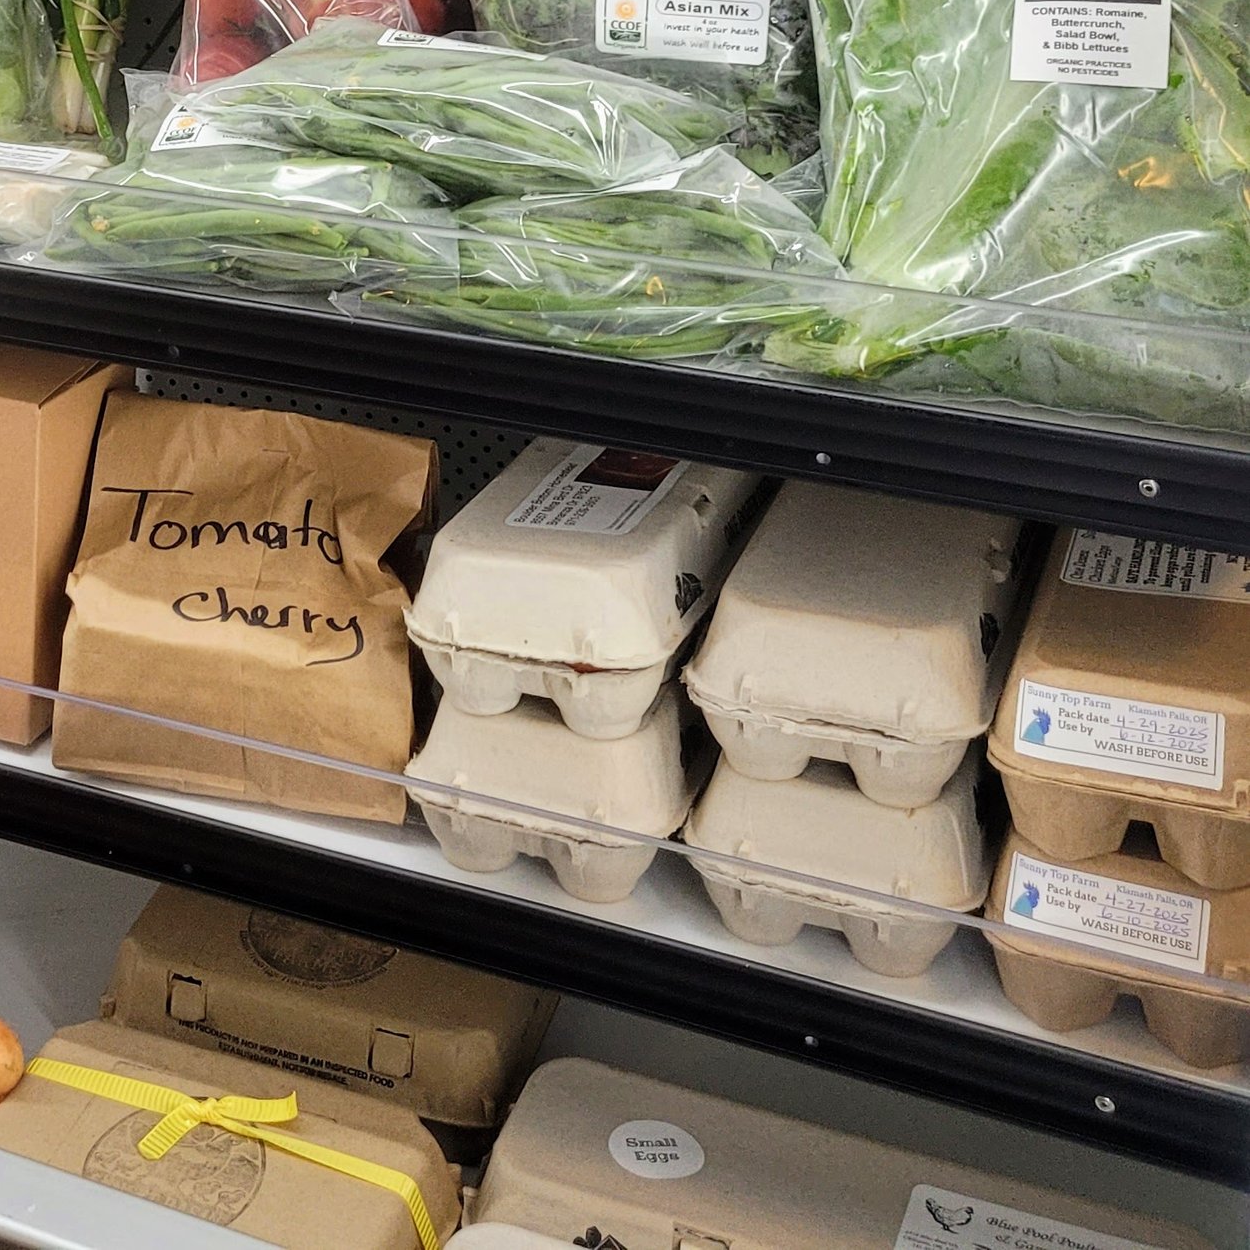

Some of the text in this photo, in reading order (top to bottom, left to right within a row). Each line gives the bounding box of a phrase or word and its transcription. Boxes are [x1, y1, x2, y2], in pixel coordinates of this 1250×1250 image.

[664, 1, 750, 17] Asian Mix
[1032, 7, 1147, 19] CONTAINS: Romaine,
[611, 20, 642, 31] CCOF
[1051, 19, 1125, 30] Buttercrunch,
[1055, 30, 1120, 42] Salad Bowl,
[1054, 41, 1079, 51] Bibb
[1082, 43, 1129, 53] Lettuces
[1046, 58, 1132, 69] ORGANIC PRACTICES
[1072, 67, 1119, 76] PESTICIDES
[101, 486, 344, 565] Tomato
[1028, 685, 1167, 719] Sunny Top Farm Klamath
[1058, 708, 1110, 724] Pack date
[1058, 720, 1094, 736] Use by
[1094, 739, 1209, 767] WASH BEFORE USE
[1018, 858, 1153, 900] Sunny Top Farm Klamath
[1047, 883, 1098, 903] Pack date
[1046, 895, 1081, 912] Use by
[1081, 917, 1192, 951] WASH BEFORE USE
[196, 1021, 232, 1043] PRODUCT
[368, 1071, 394, 1088] FOOD
[626, 1138, 678, 1147] Small
[634, 1151, 680, 1163] Eggs
[986, 1216, 1055, 1243] Blue Pool
